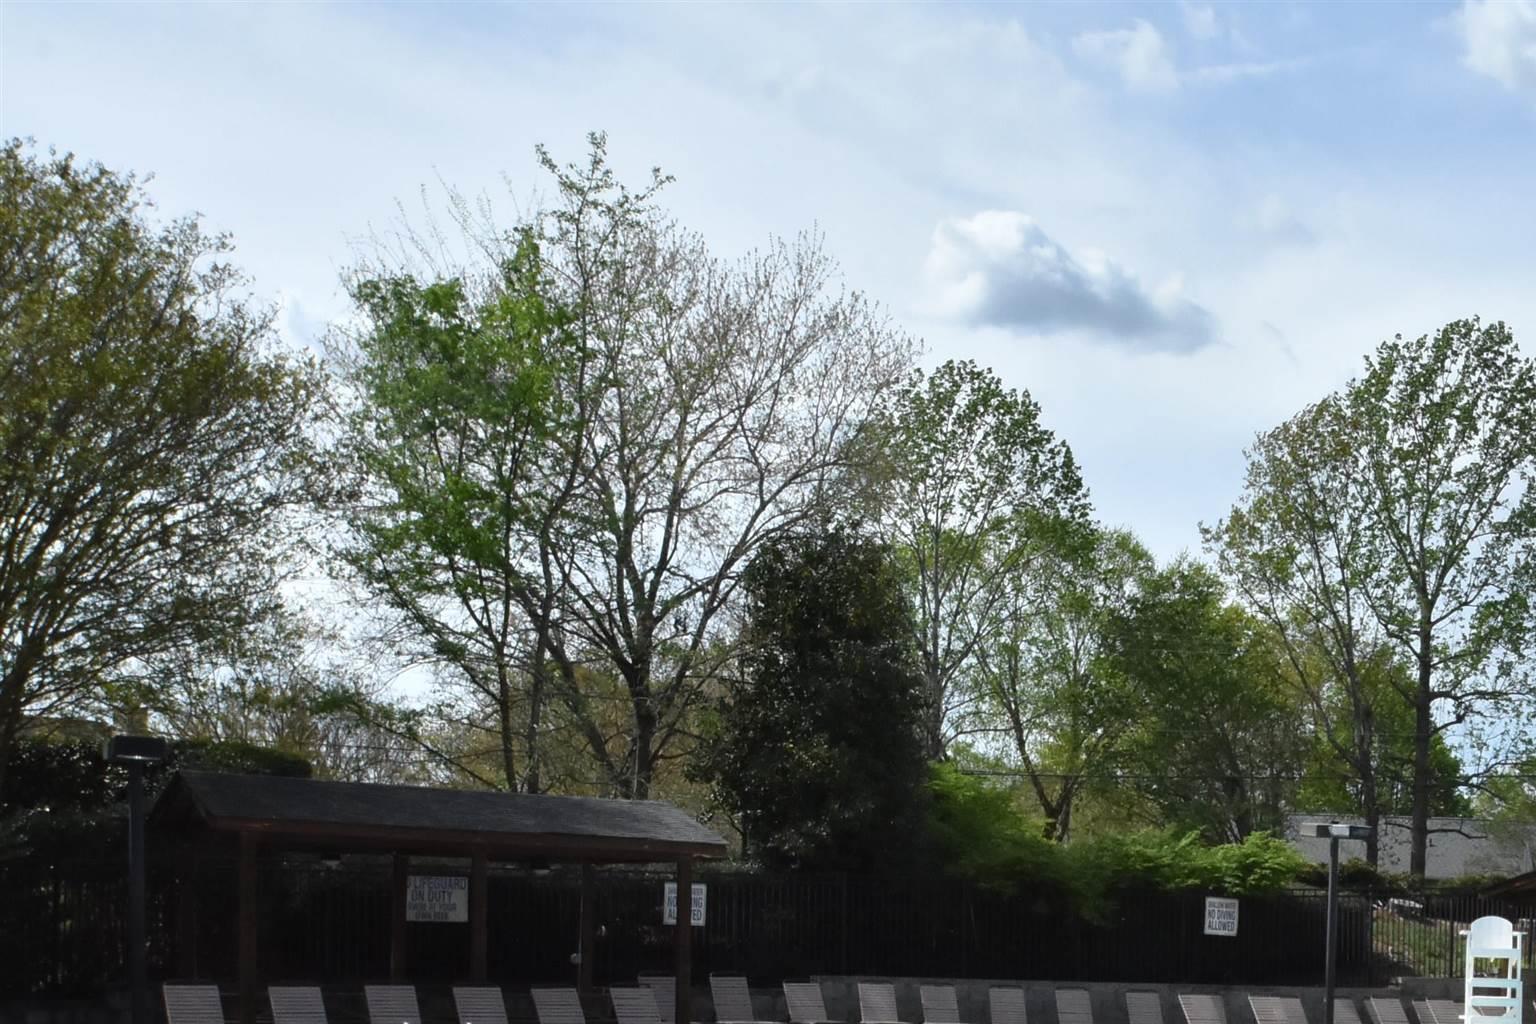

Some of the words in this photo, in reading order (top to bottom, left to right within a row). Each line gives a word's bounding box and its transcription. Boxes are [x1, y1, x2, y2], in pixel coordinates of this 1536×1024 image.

[414, 878, 467, 889] LIFEGUARD
[410, 889, 425, 902] ON
[427, 889, 453, 903] DUTY
[1208, 909, 1215, 919] NO
[1217, 910, 1235, 920] DIVING
[1208, 920, 1235, 932] ALLOWED
